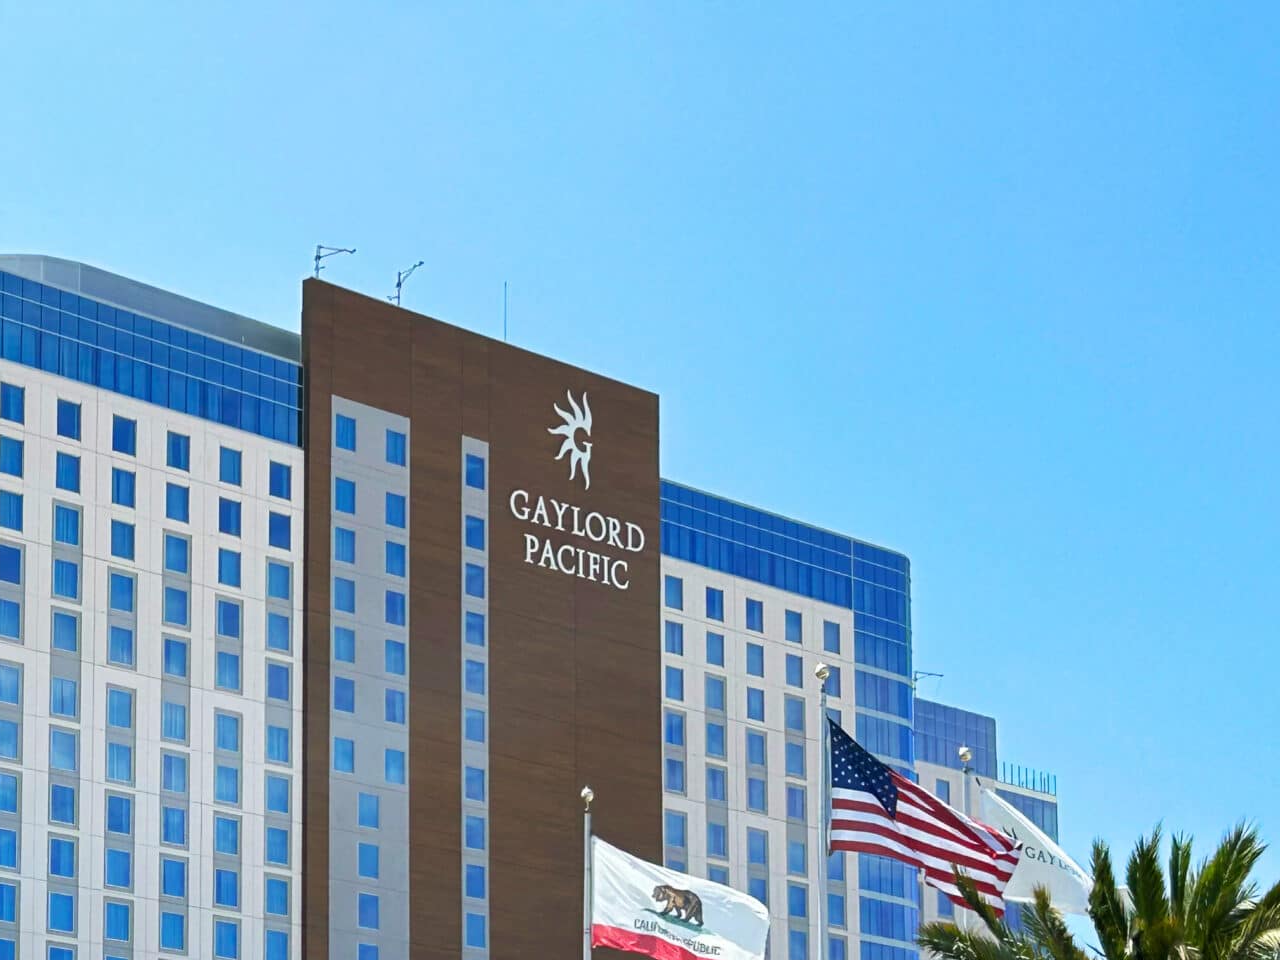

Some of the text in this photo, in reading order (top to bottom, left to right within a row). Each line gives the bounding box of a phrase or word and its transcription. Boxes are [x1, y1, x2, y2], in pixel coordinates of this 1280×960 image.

[510, 490, 645, 552] GAYLORD
[523, 533, 630, 590] PACIFIC
[1025, 846, 1083, 880] GAYL
[634, 918, 683, 943] CALIFO
